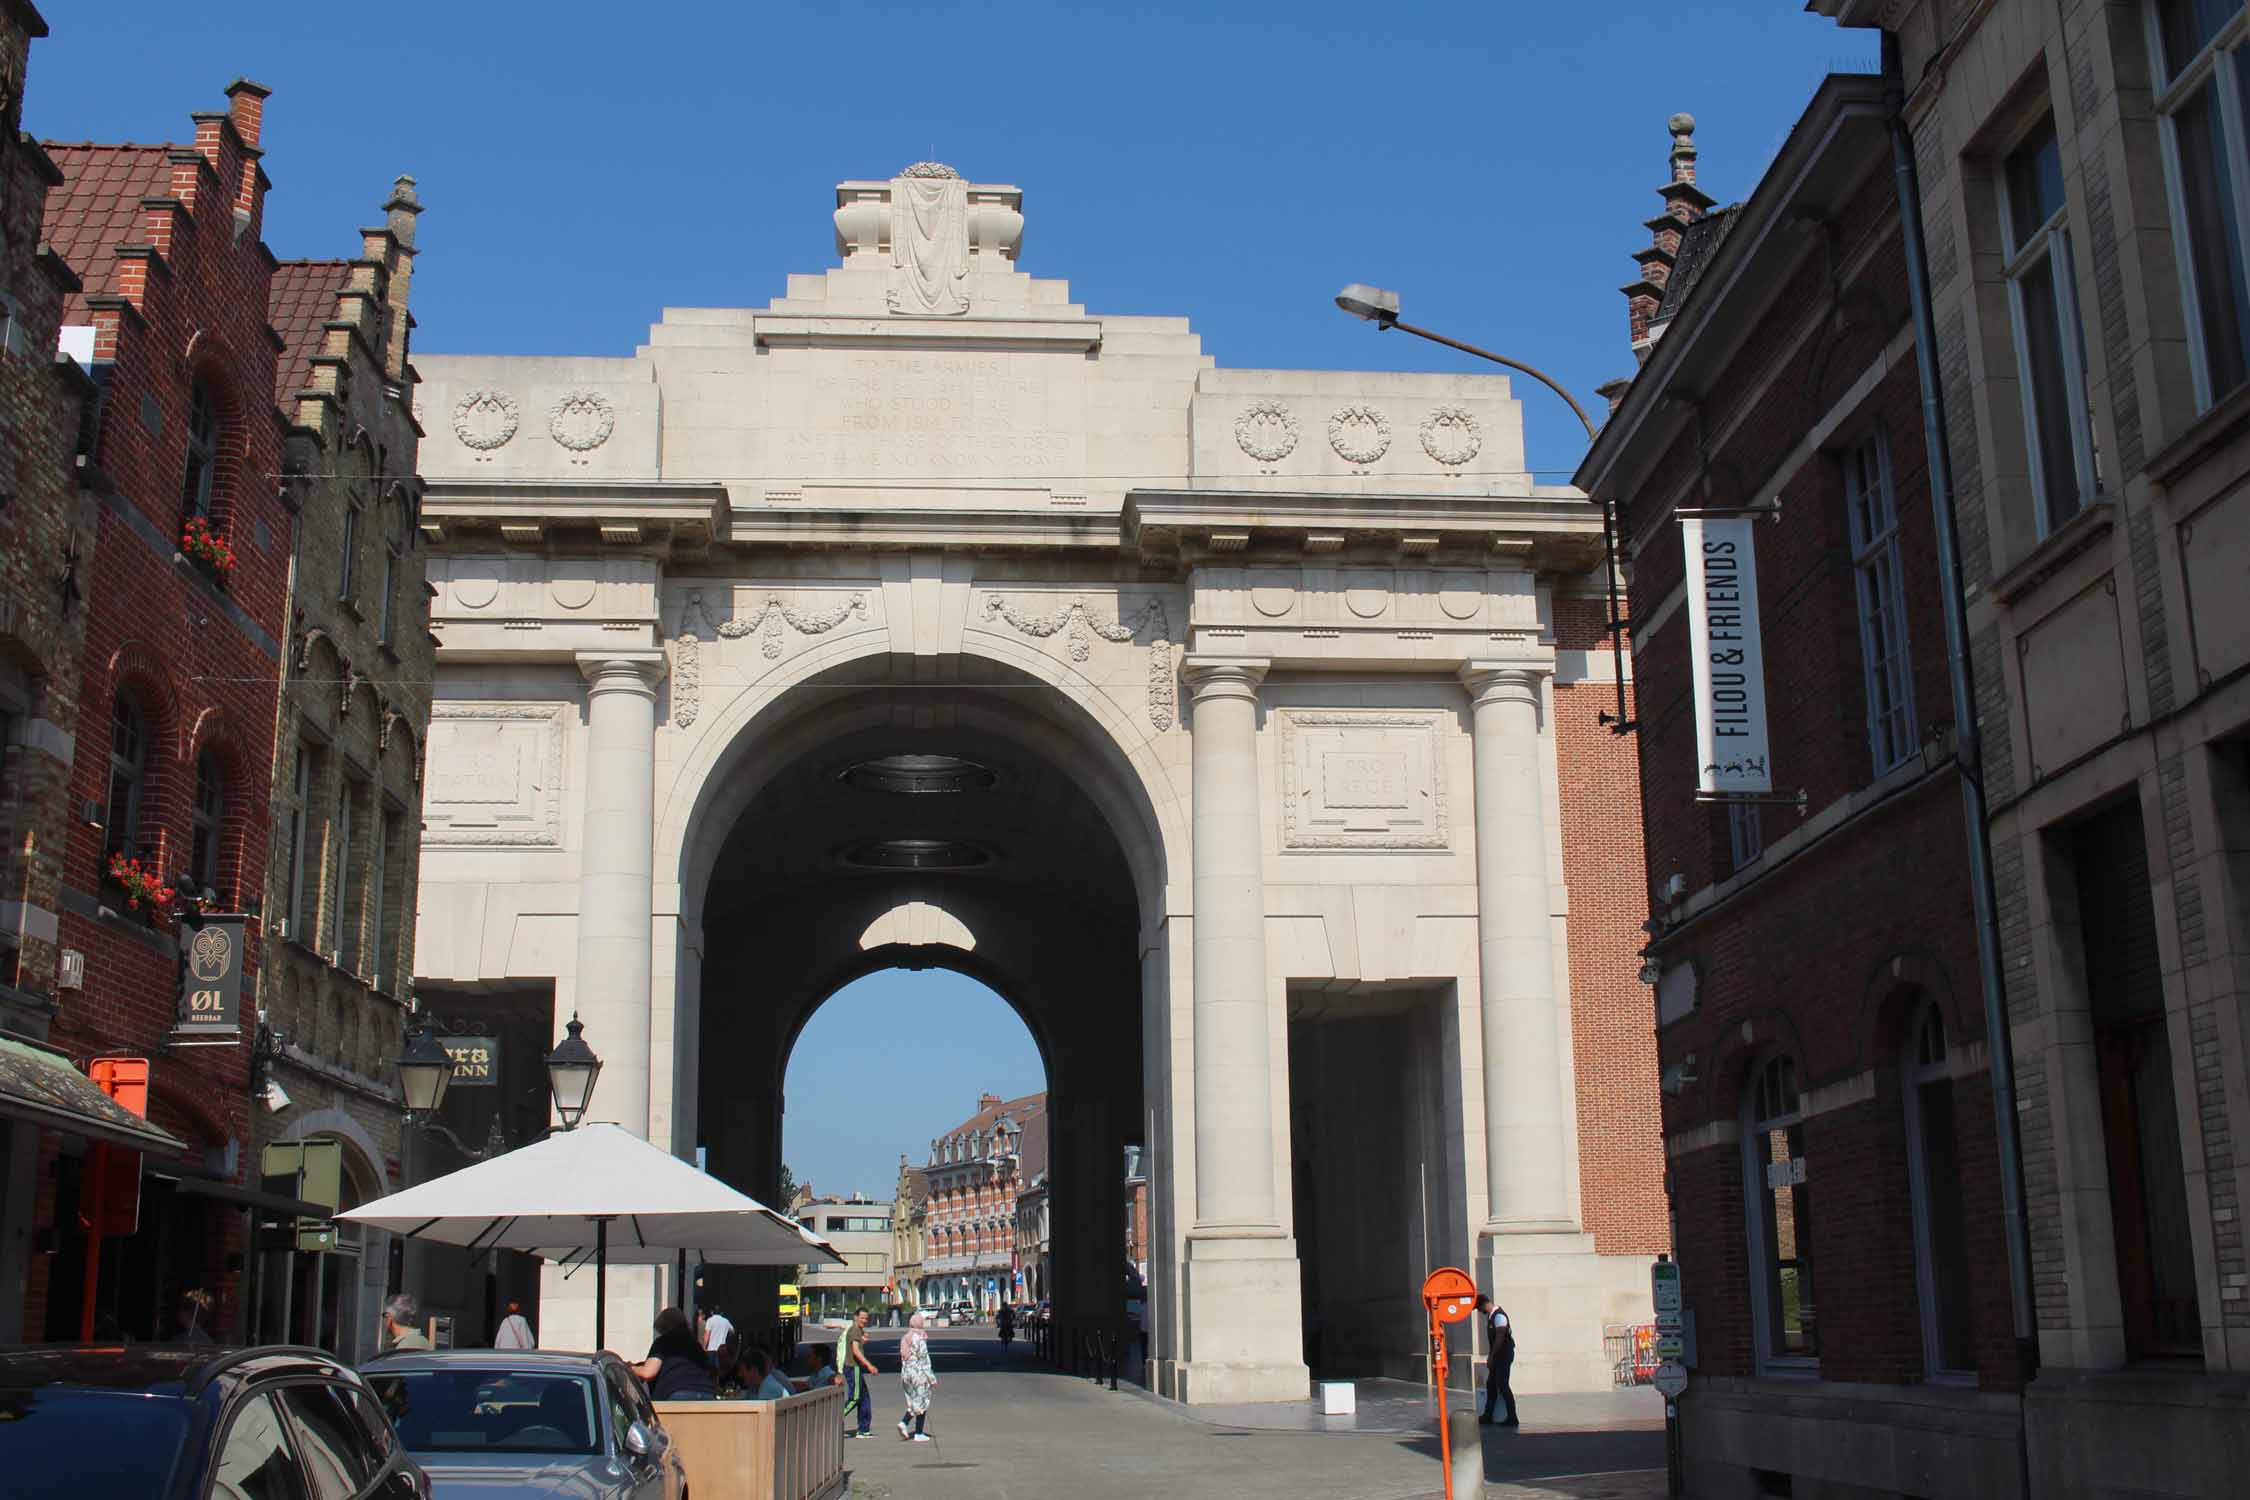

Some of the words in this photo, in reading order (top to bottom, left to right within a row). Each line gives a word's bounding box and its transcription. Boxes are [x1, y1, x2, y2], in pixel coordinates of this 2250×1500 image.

[889, 397, 952, 412] STOOD
[842, 414, 896, 430] FROM
[1702, 541, 1742, 640] FRIENDS
[1711, 648, 1744, 666] &
[1711, 672, 1749, 736] FILOU
[191, 990, 225, 1011] ØL
[453, 1064, 488, 1077] INN
